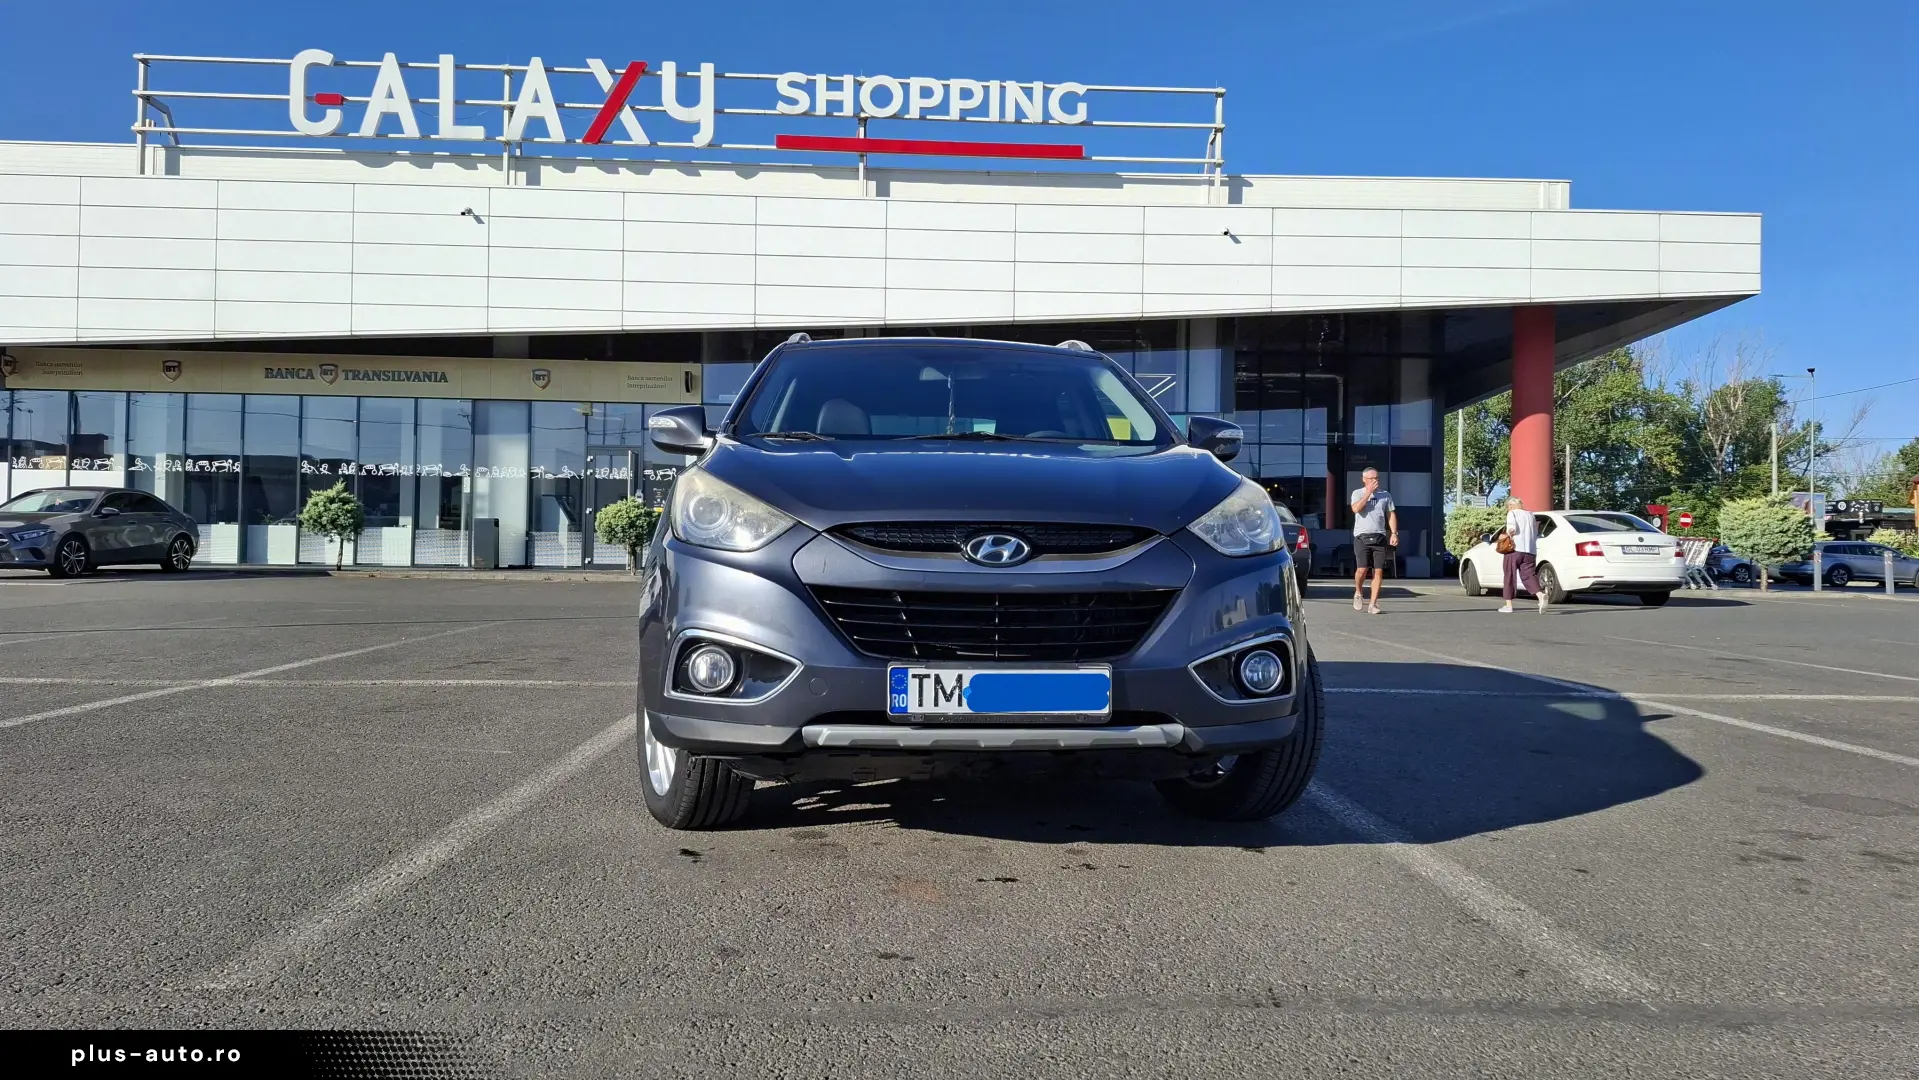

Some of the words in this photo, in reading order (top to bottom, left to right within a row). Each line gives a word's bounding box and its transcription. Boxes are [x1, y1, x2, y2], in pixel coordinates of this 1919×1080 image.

[289, 48, 715, 148] GALAXY
[776, 72, 1088, 125] SHOPPING
[164, 365, 178, 373] BT
[264, 367, 315, 380] BANCA
[342, 368, 449, 383] TRANSILVANIA
[534, 373, 547, 381] BT
[911, 673, 963, 707] TM
[891, 693, 907, 707] RO
